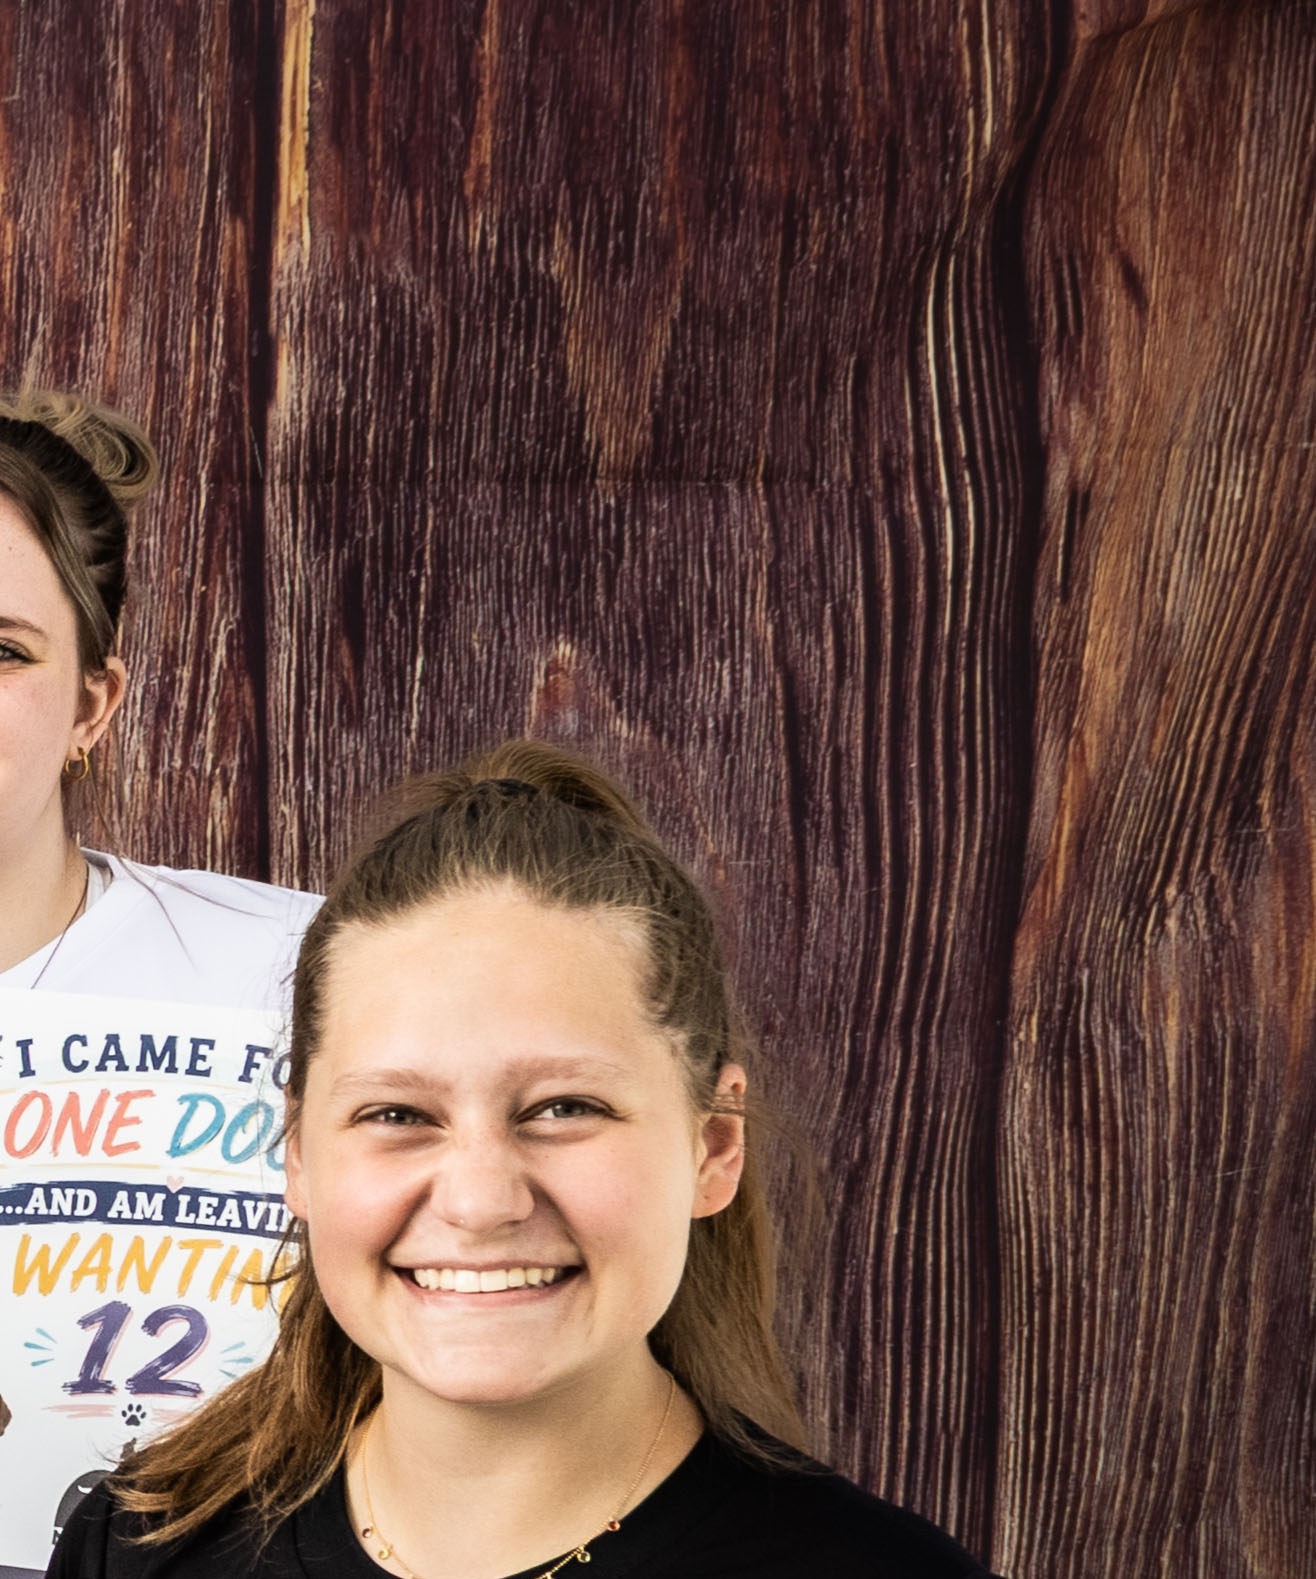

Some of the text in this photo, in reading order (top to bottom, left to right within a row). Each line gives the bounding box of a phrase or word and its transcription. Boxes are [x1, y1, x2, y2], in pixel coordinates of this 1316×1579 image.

[16, 1033, 292, 1090] I CAME FO
[4, 1088, 156, 1159] ONE
[107, 1190, 166, 1221] AM
[12, 1232, 298, 1312] WANTIN
[61, 1300, 208, 1399] 12
